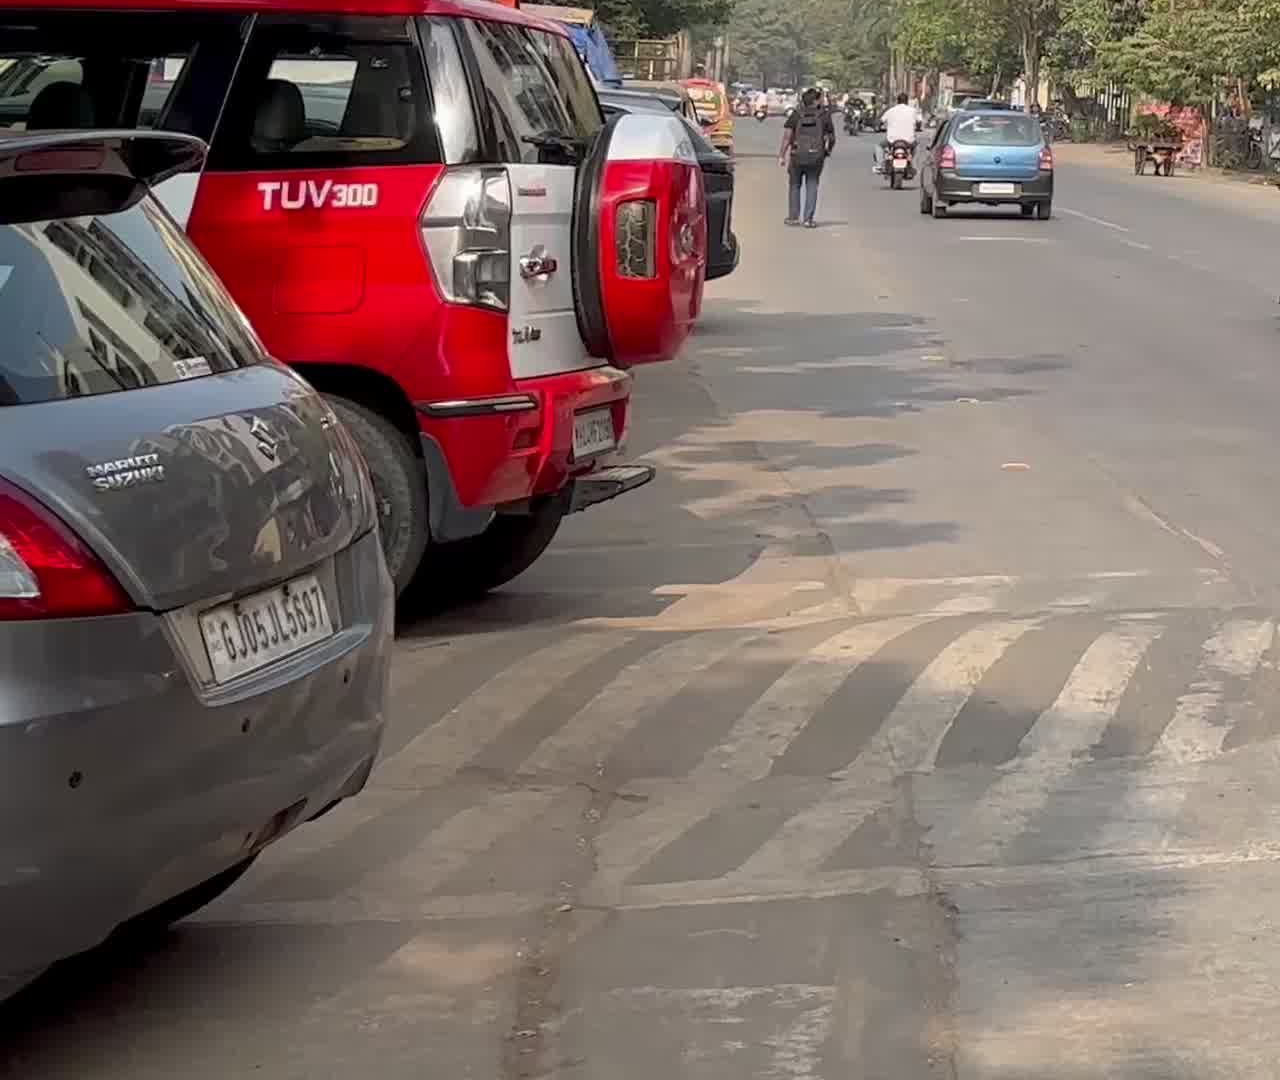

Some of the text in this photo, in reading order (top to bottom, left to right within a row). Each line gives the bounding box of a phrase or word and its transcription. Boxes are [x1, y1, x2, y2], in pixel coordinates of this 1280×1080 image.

[257, 179, 379, 211] TUV300
[86, 453, 159, 475] MARUTI
[94, 465, 164, 490] SUZUKI
